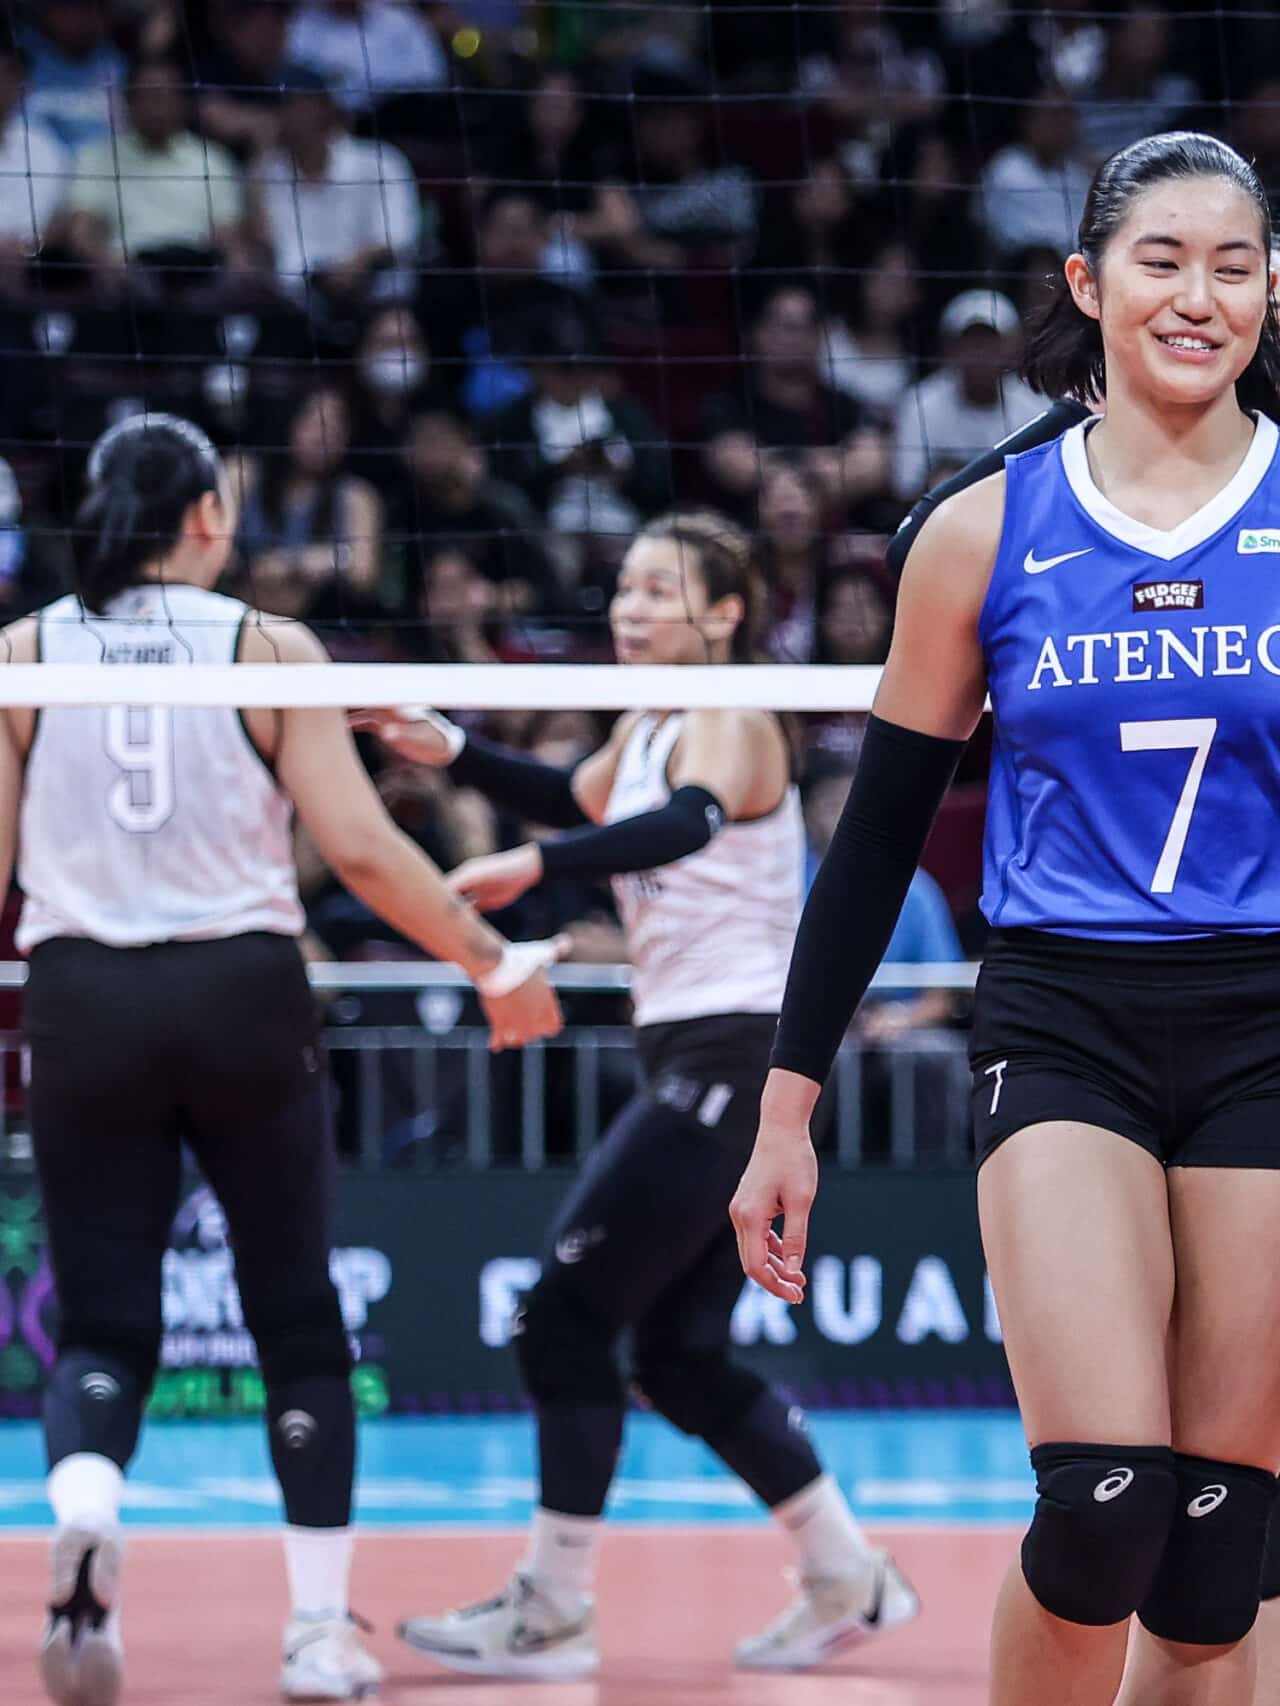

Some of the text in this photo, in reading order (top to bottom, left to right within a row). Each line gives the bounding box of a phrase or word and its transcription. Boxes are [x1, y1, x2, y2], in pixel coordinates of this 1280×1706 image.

[1134, 583, 1199, 604] FUDGEE
[1153, 595, 1196, 609] BARR
[102, 703, 176, 834] 9
[1119, 717, 1217, 893] 7
